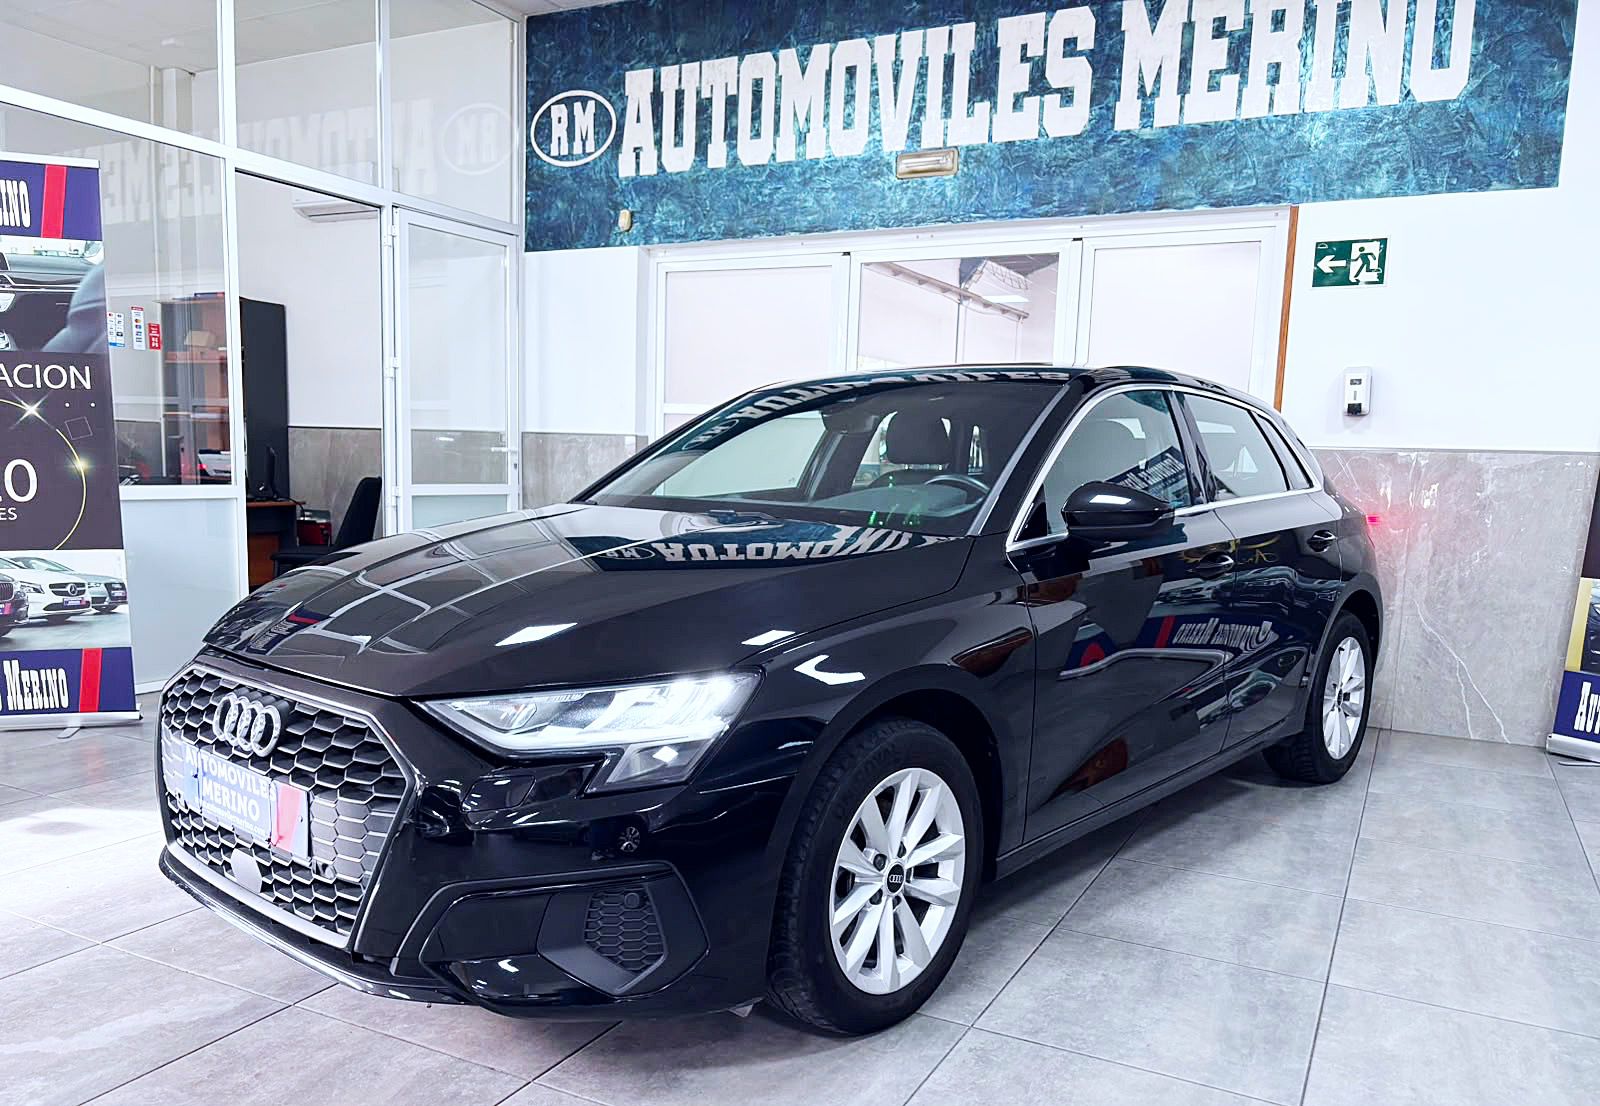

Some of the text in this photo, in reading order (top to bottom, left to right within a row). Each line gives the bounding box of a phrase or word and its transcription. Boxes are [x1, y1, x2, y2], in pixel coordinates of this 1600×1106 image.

[618, 0, 1476, 178] AUTOMOVILES MERINO
[550, 100, 596, 157] RM
[0, 179, 31, 228] INO
[0, 363, 92, 390] ACION
[202, 776, 260, 821] MERINO
